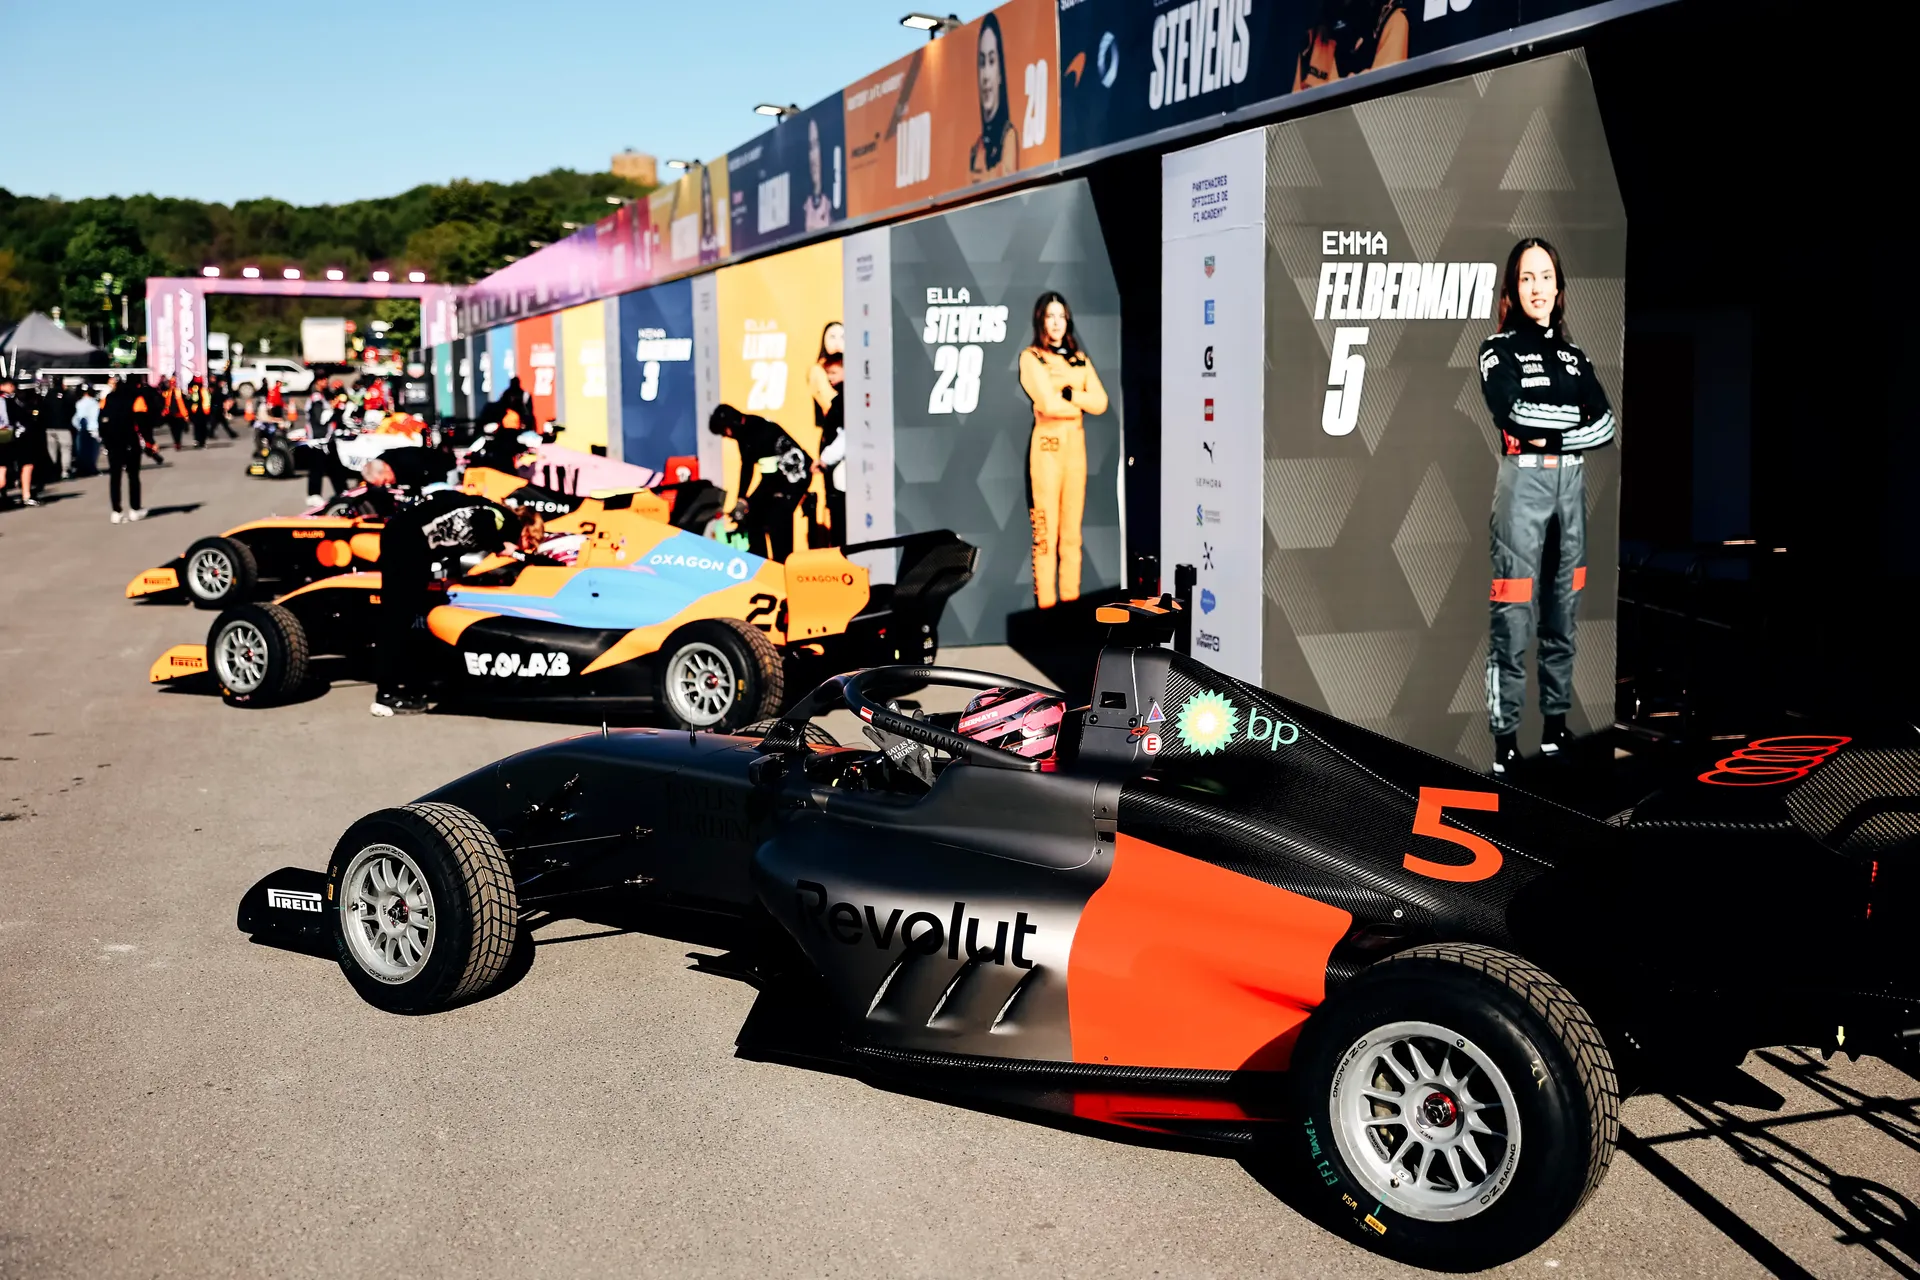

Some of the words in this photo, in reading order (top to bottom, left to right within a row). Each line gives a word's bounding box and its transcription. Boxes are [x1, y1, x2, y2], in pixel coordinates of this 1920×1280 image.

[1149, 0, 1251, 110] STEVENS
[1191, 174, 1228, 191] PARTENAIRES
[1191, 192, 1220, 208] OFFICIELS
[1221, 190, 1228, 201] DE
[1193, 211, 1200, 223] F1
[1321, 230, 1388, 256] EMMA
[926, 287, 970, 304] ELLA
[1314, 262, 1497, 320] FELBERMAYR
[923, 305, 1009, 344] STEVENS
[928, 344, 984, 414] 28
[1321, 326, 1370, 437] 5
[1195, 477, 1222, 488] SEPHORA
[650, 555, 724, 572] OXAGON
[797, 574, 839, 583] OXAGON
[464, 652, 571, 678] ECOLAB
[1247, 706, 1299, 751] bp
[1146, 737, 1157, 751] E
[1403, 786, 1503, 882] 5
[267, 888, 322, 913] PIRELLI
[796, 878, 1037, 970] Revolut
[1332, 1058, 1350, 1098] RACING
[1499, 1143, 1517, 1186] RACING
